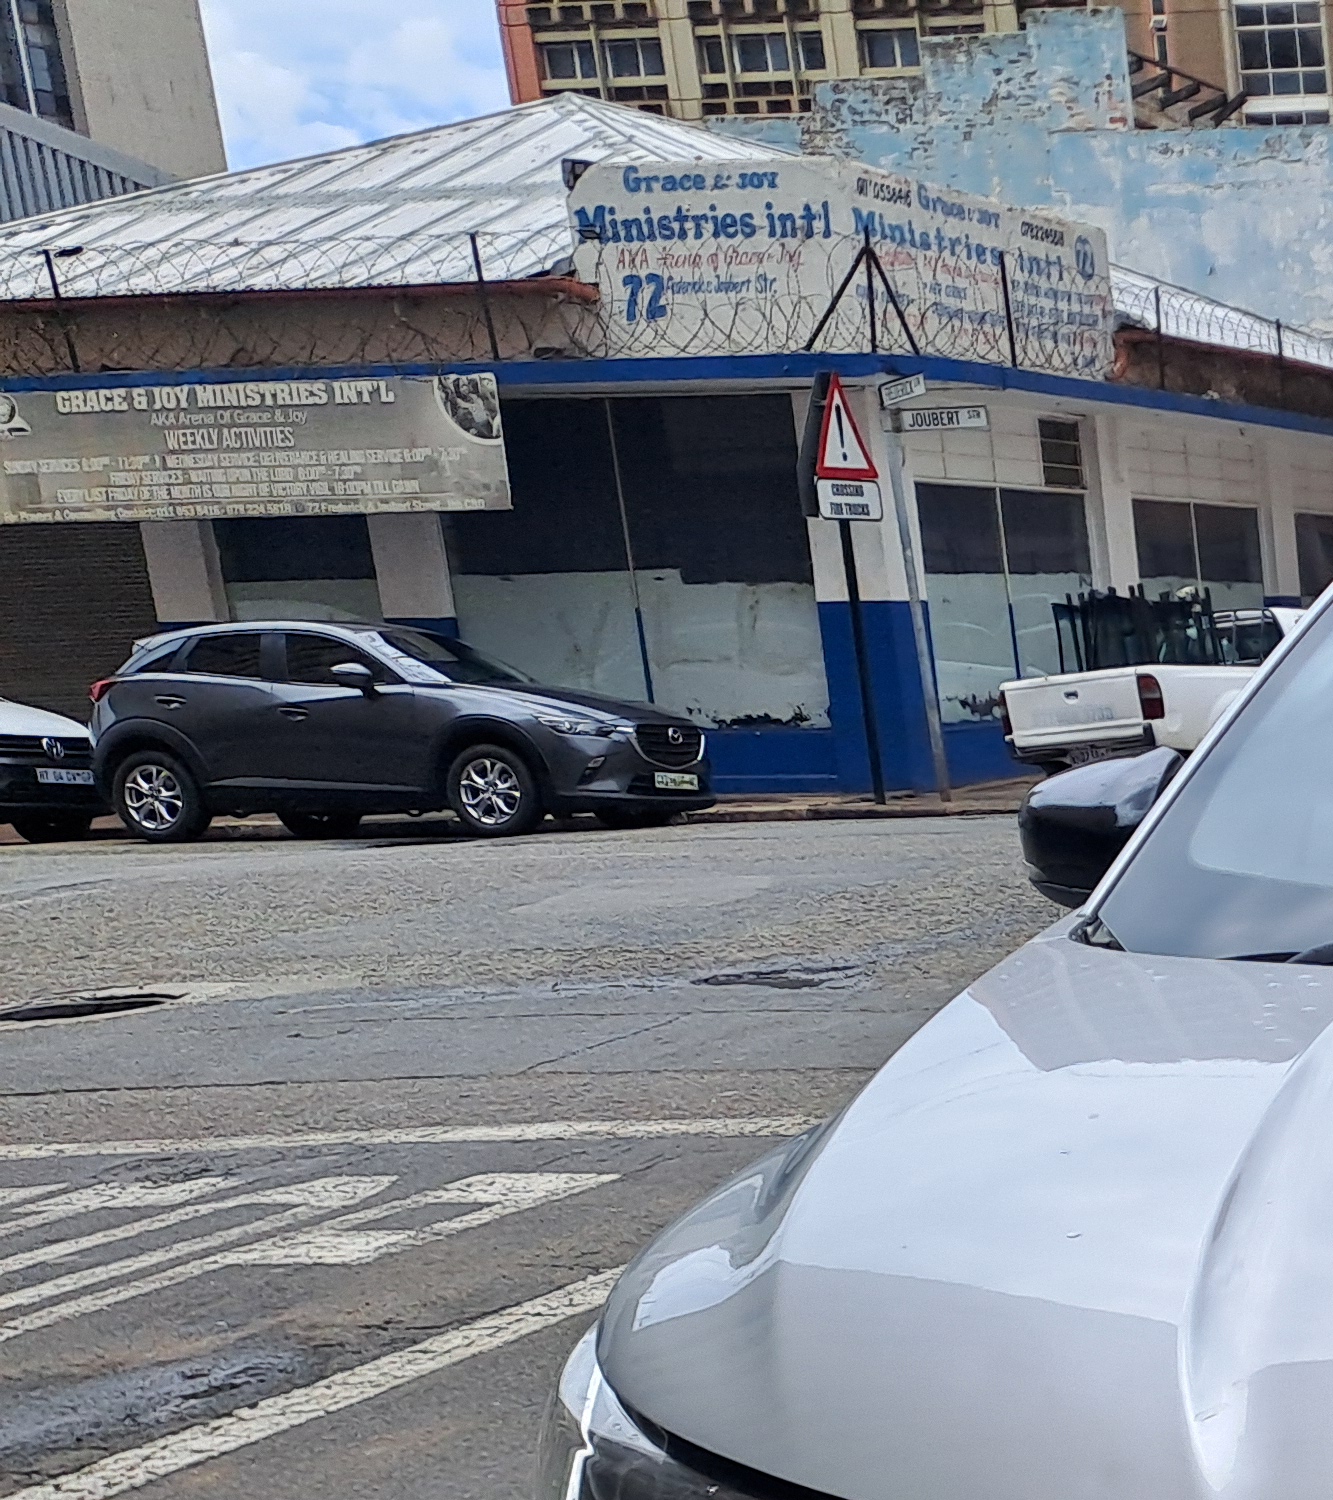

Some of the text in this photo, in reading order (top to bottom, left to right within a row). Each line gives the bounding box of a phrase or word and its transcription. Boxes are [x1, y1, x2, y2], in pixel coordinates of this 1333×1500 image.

[623, 165, 706, 193] Grace
[574, 203, 757, 245] Ministries
[851, 206, 1001, 267] Ministries
[622, 272, 669, 322] 72
[56, 381, 394, 413] GRACE & JOY MINISTRIES INT'L
[150, 408, 307, 427] AKA Arena Of Grace & Joy
[909, 410, 961, 428] JOUBERT
[164, 426, 295, 450] WEEKLY ACTIVITIES
